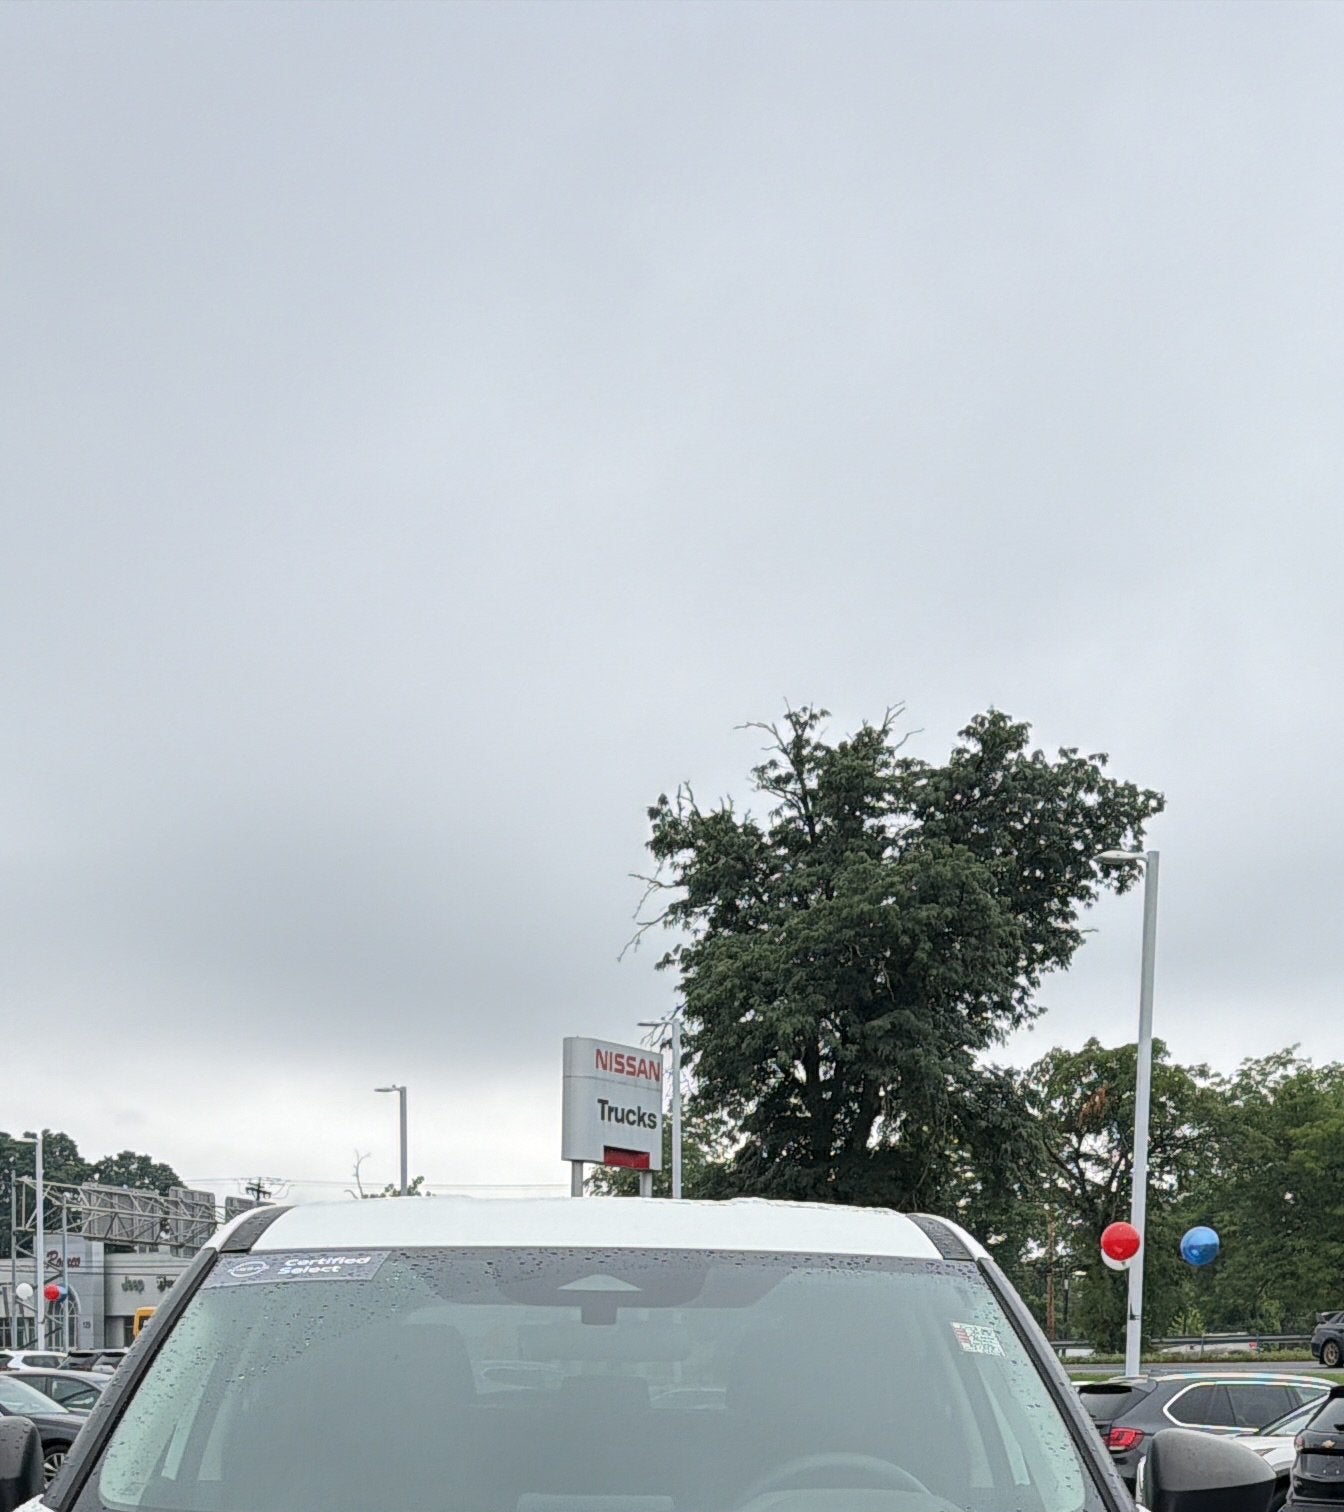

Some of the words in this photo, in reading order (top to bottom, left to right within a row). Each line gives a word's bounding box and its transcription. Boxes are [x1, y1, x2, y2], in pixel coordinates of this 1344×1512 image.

[594, 1048, 661, 1082] NISSAN
[597, 1098, 657, 1130] Trucks
[277, 1264, 342, 1275] Select
[284, 1256, 371, 1266] Certified
